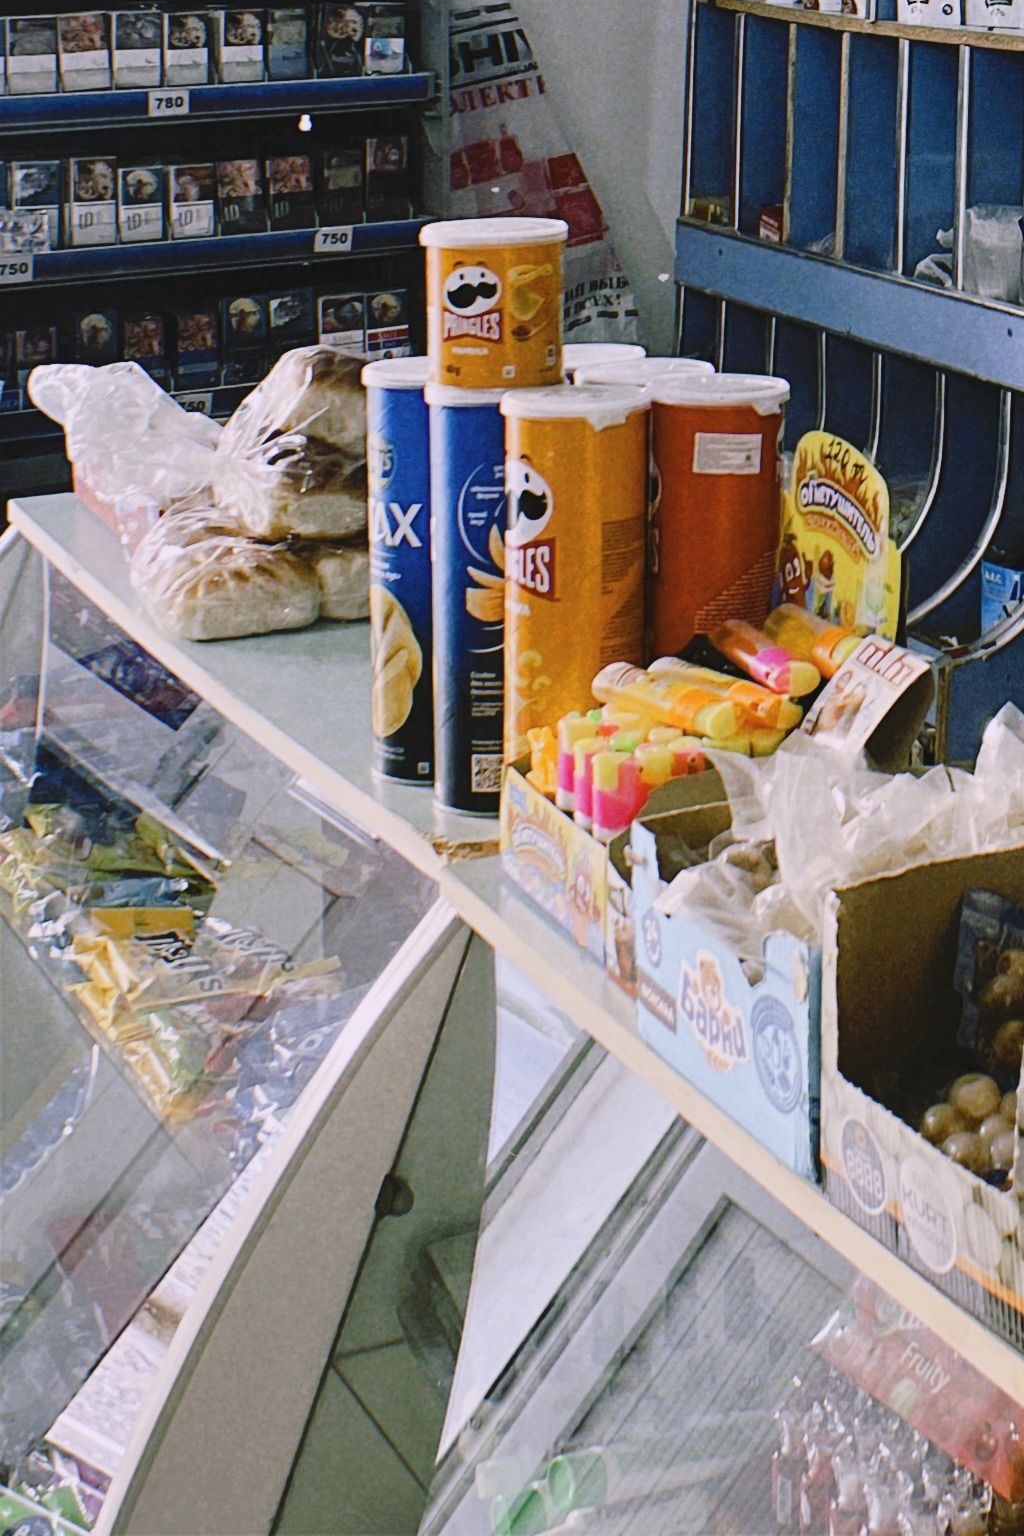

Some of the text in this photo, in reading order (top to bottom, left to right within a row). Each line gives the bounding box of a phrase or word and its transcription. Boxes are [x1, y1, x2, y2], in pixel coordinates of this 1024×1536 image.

[155, 96, 184, 110] 780
[321, 232, 348, 245] 750
[444, 311, 500, 340] PRINGLES
[681, 964, 748, 1062] Барни
[900, 1341, 952, 1394] Fruity
